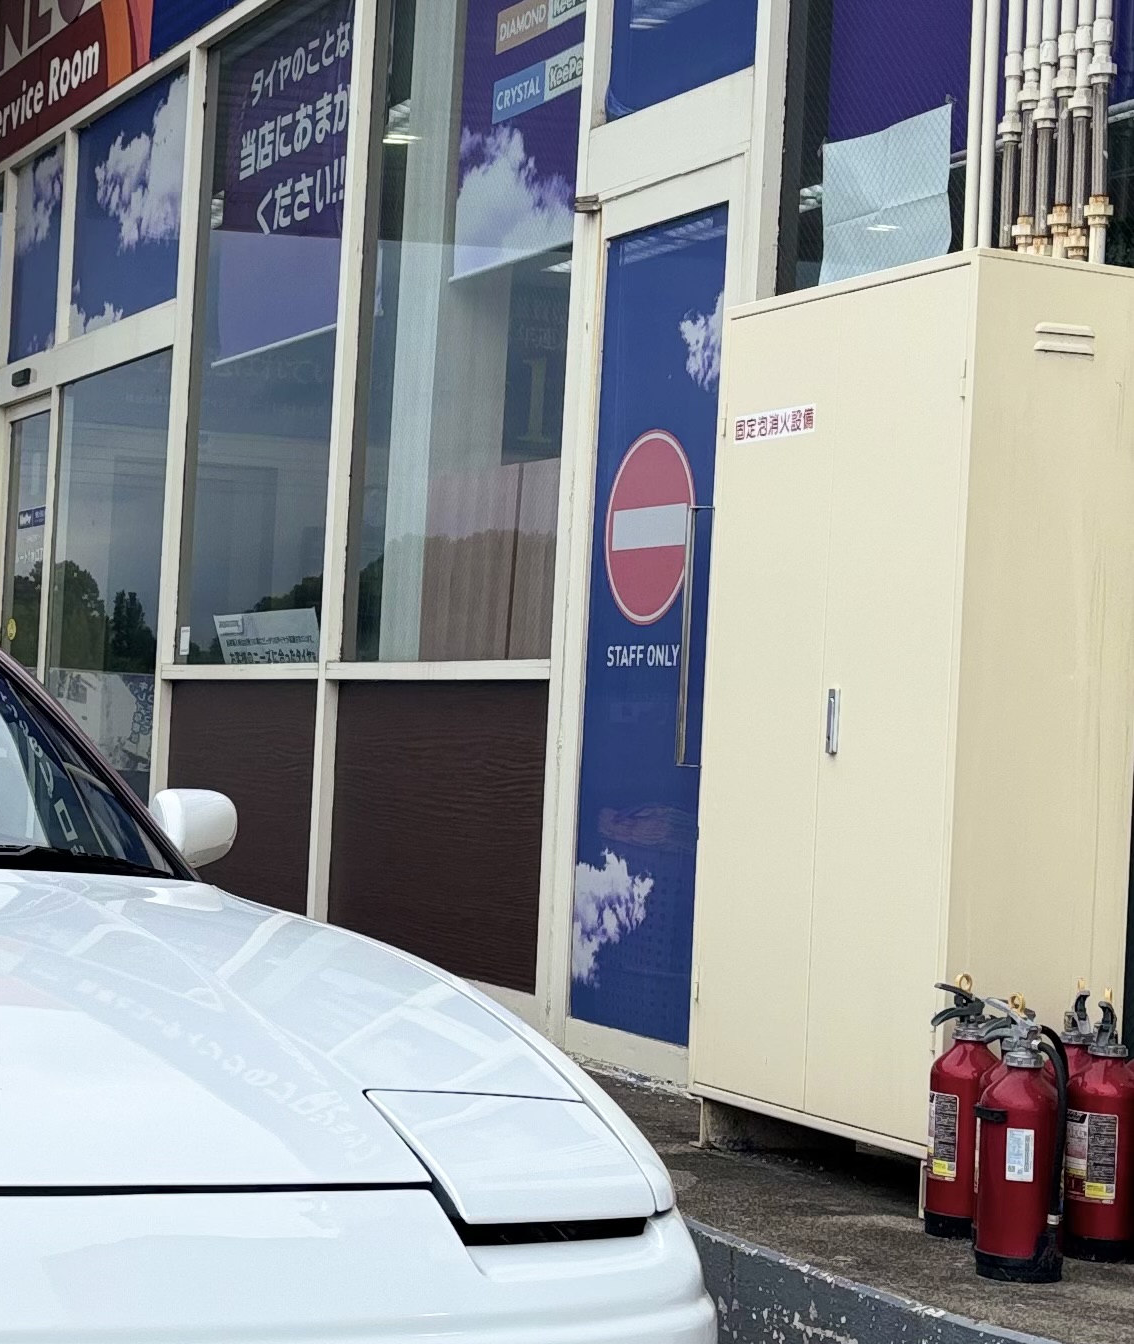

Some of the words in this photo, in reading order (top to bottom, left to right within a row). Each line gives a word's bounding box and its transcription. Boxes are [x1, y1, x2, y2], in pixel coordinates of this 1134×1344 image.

[499, 4, 547, 42] DIAMOND
[48, 40, 100, 106] Room
[251, 21, 352, 107] タイヤのことな
[496, 76, 541, 111] CRYSTAL
[549, 57, 583, 91] KeePe
[239, 83, 351, 181] 当店におまか
[735, 407, 814, 441] 固定泡消火設備
[607, 645, 645, 667] STAFF
[647, 644, 680, 667] ONLY
